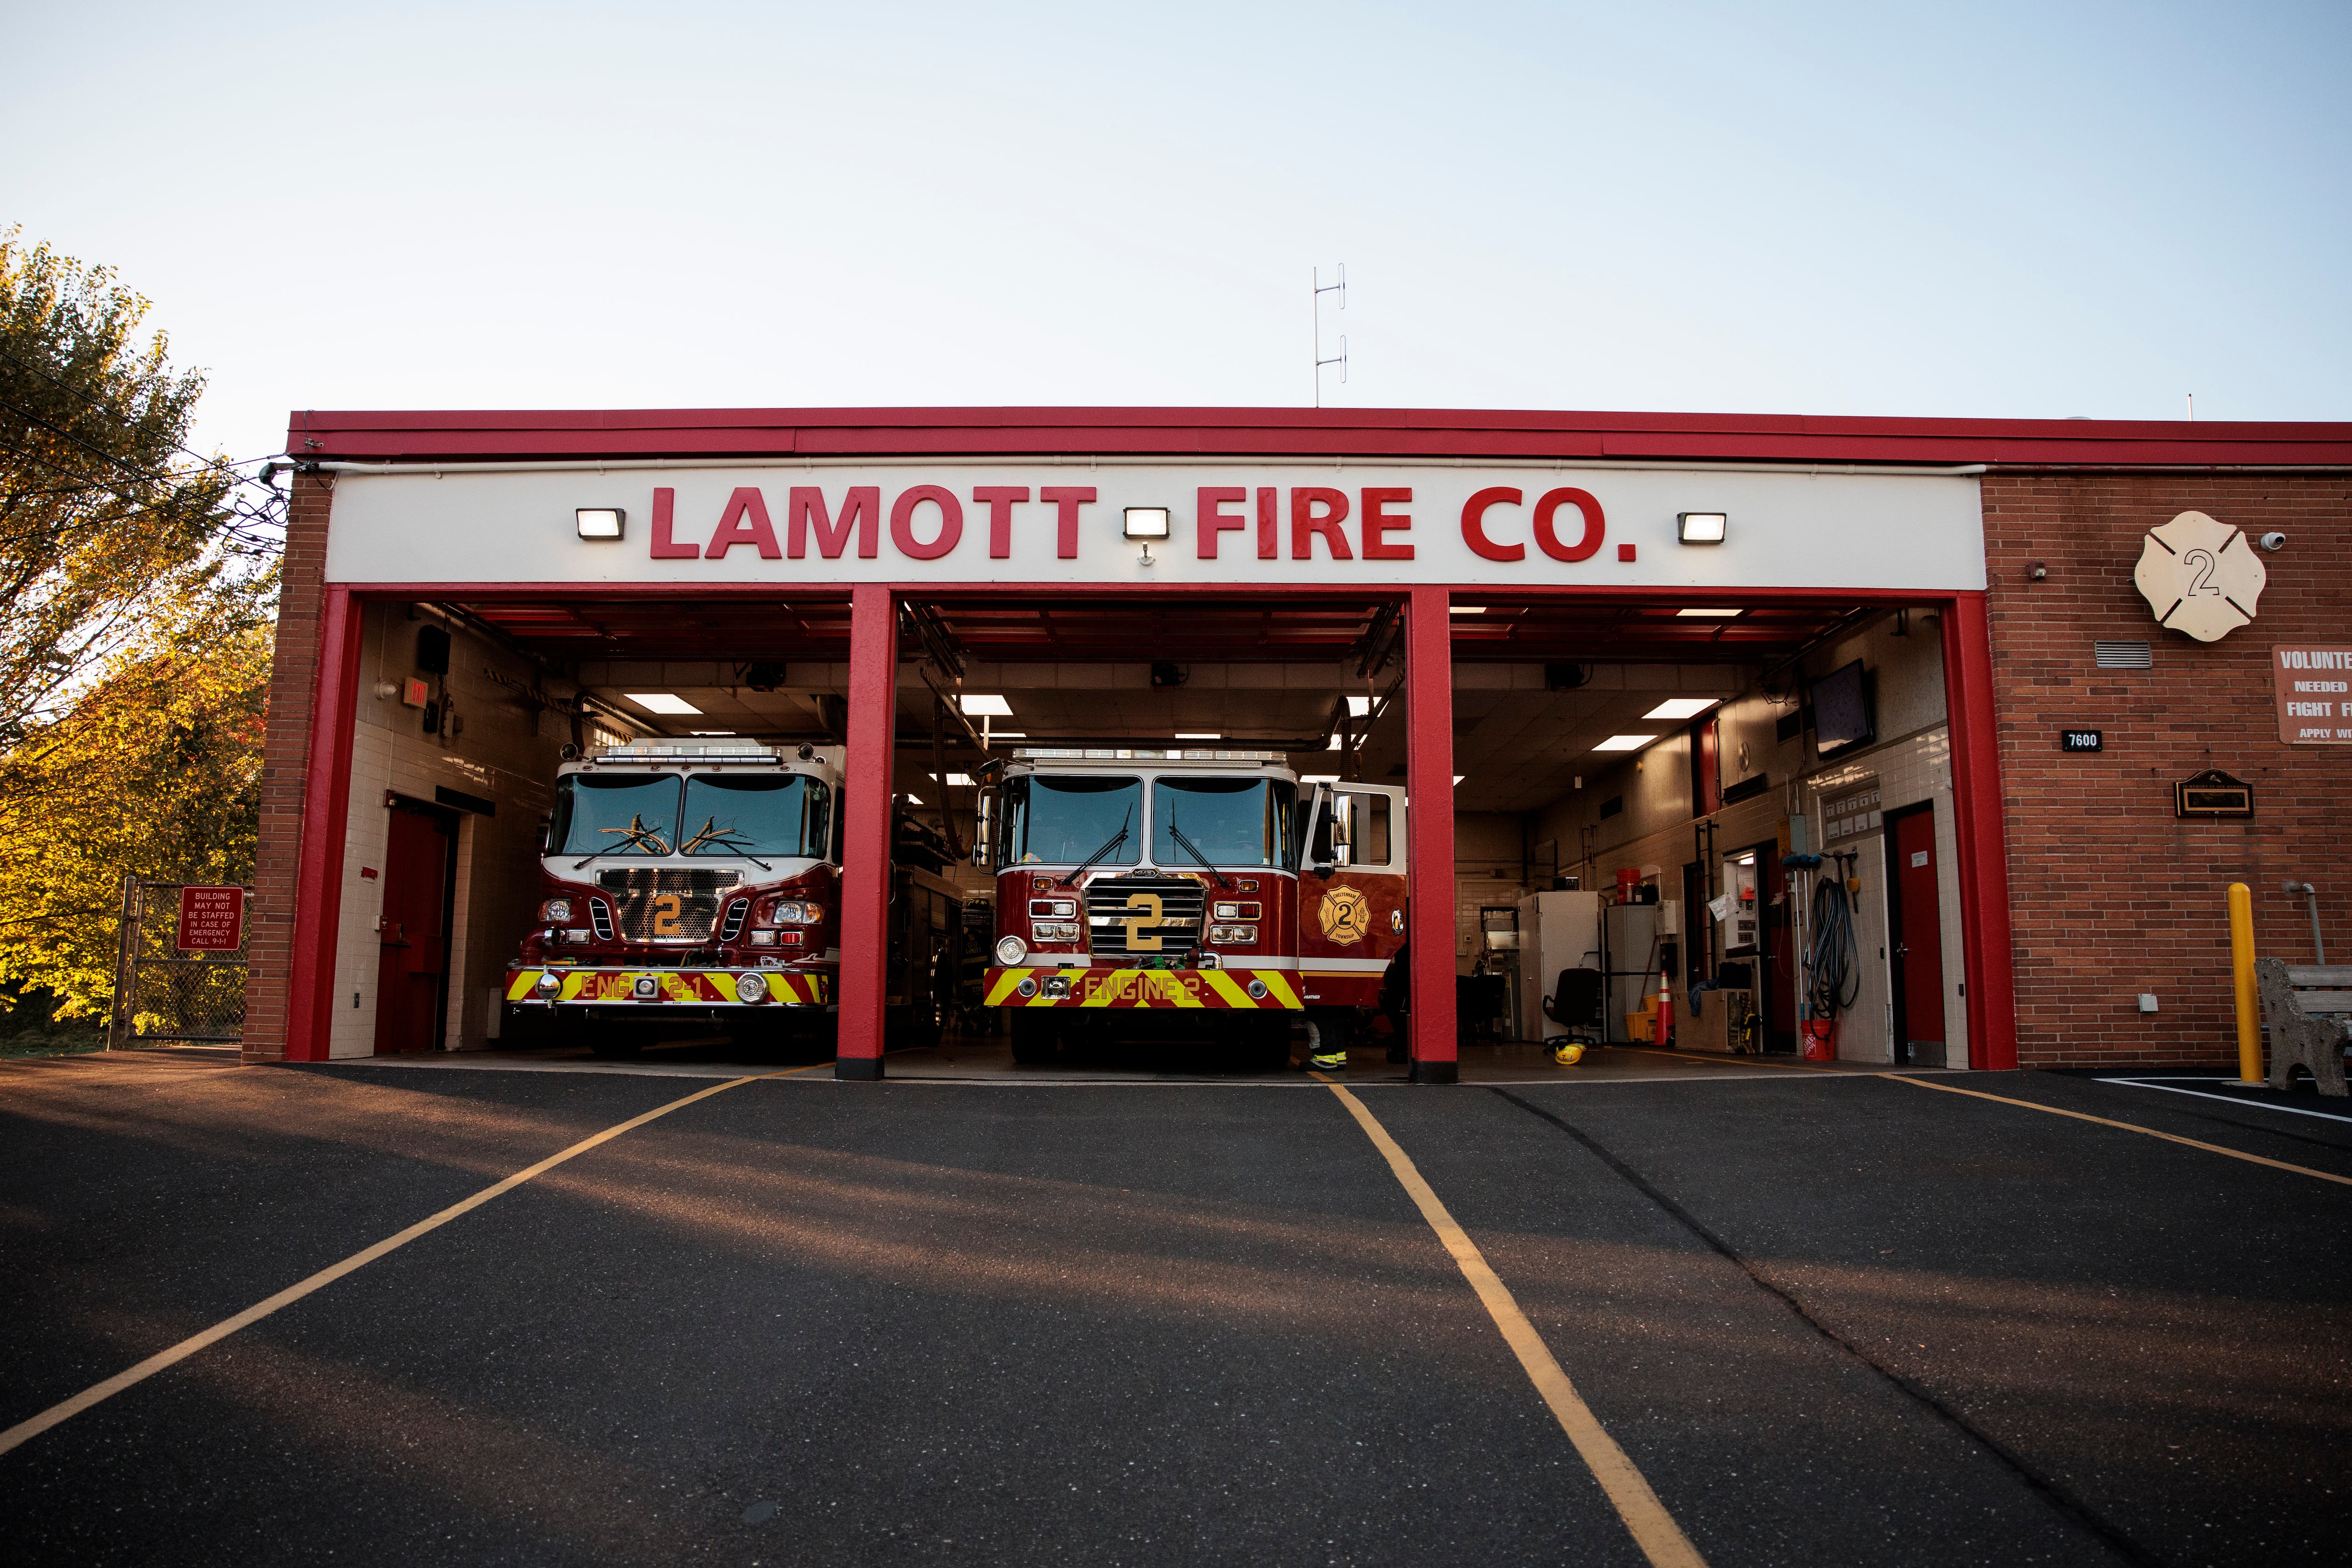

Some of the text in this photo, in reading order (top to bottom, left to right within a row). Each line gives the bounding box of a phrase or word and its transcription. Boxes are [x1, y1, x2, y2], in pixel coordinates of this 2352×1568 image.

[650, 485, 1636, 562] LAMOTT FIRE CO.
[2184, 549, 2219, 596] 2
[412, 682, 426, 704] EXIT
[2295, 681, 2347, 692] NEEDED
[2287, 702, 2332, 716] FIGHT
[2069, 735, 2097, 746] 7600
[2299, 729, 2352, 738] APPLY WI
[654, 895, 681, 934] 2
[1127, 894, 1162, 950] 2
[1338, 904, 1351, 925] 2
[581, 976, 702, 998] ENG 2-1
[1085, 977, 1200, 1000] ENGINE 2
